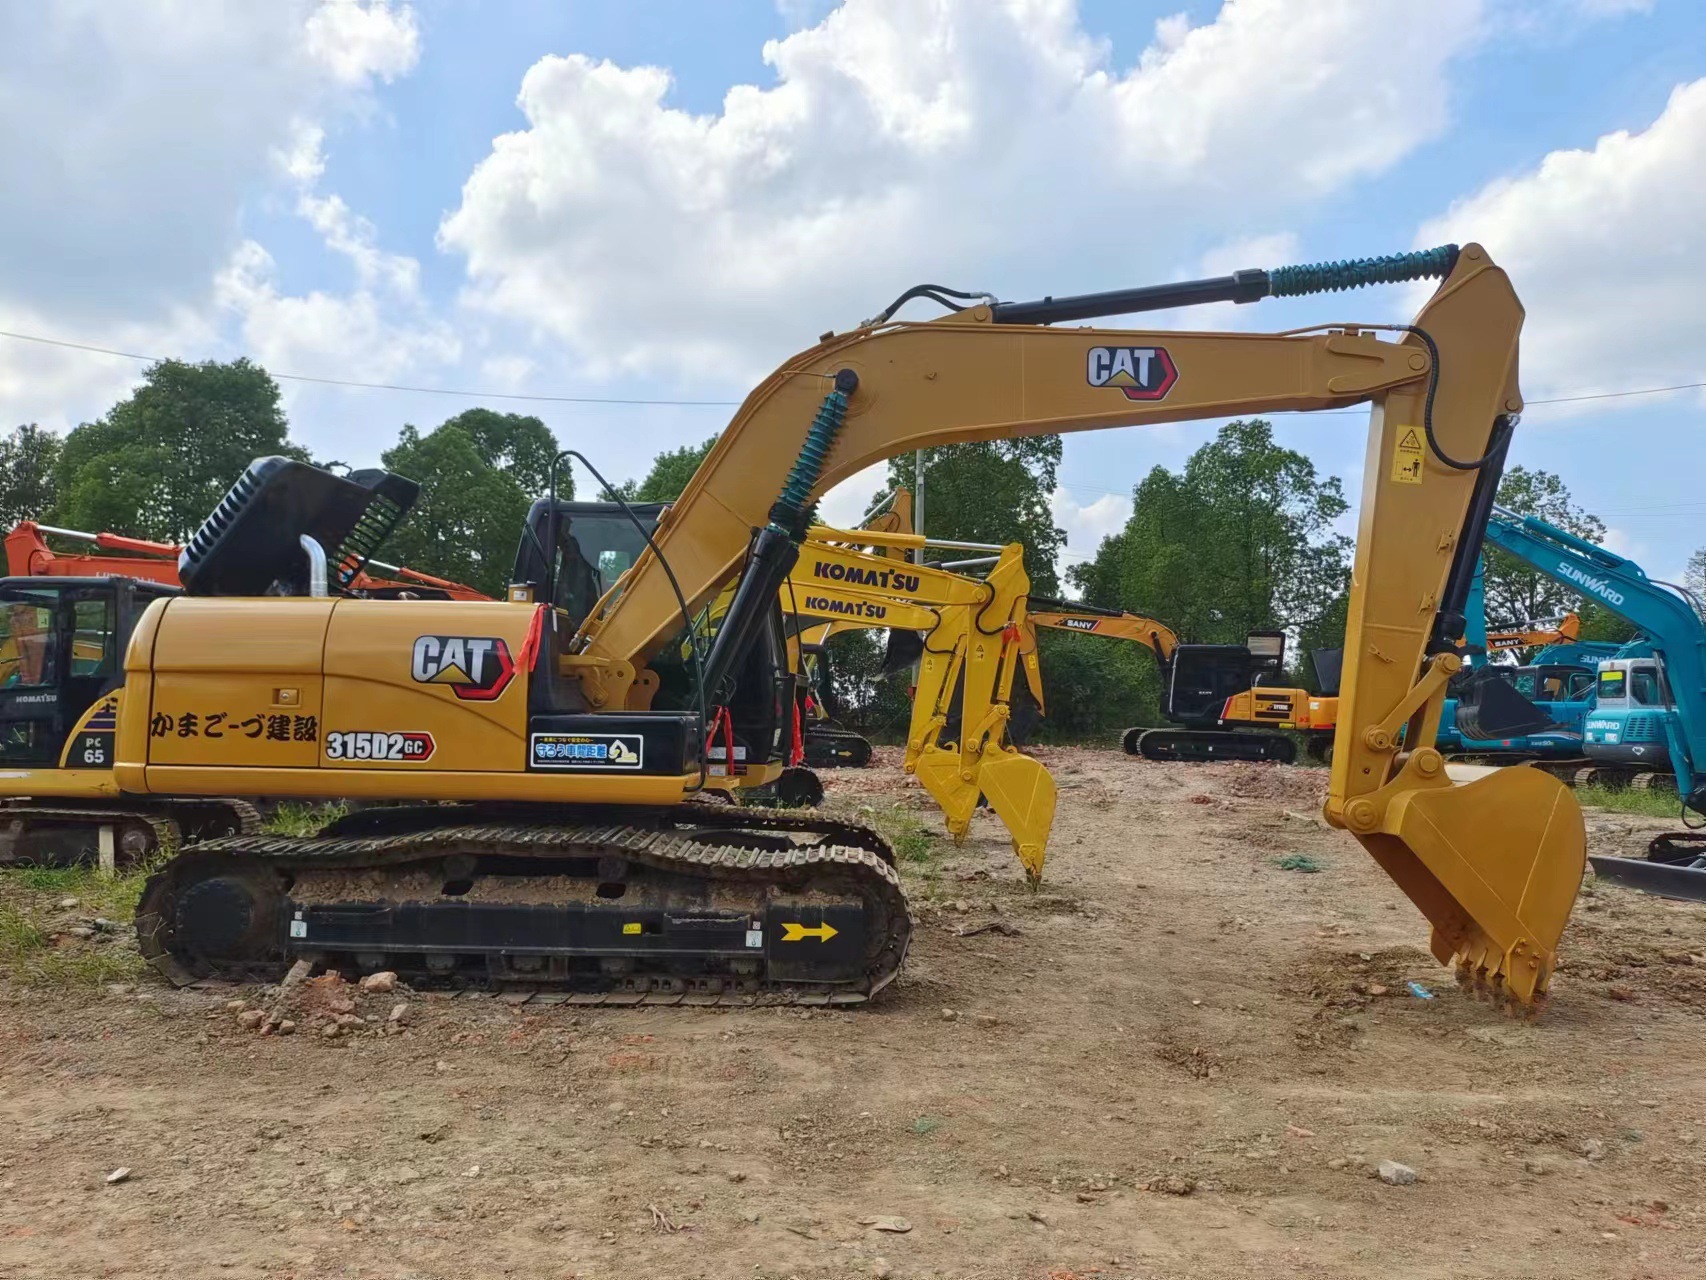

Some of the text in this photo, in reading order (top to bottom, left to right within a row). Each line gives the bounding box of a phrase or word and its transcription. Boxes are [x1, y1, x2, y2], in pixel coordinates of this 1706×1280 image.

[1088, 347, 1155, 387] CAT
[814, 561, 919, 592] KOMATSU
[1556, 562, 1624, 605] SUNWARD
[805, 596, 886, 619] KOMATSU
[1067, 619, 1092, 629] SANY
[1494, 639, 1519, 647] SANY
[413, 636, 492, 684] CAT
[16, 694, 57, 703] KOMATSU
[1586, 720, 1620, 730] SUNWARD
[86, 738, 101, 747] PC
[326, 732, 424, 760] 315D2 GC
[84, 750, 104, 763] 65
[535, 743, 608, 759] 守ろう車間距離
